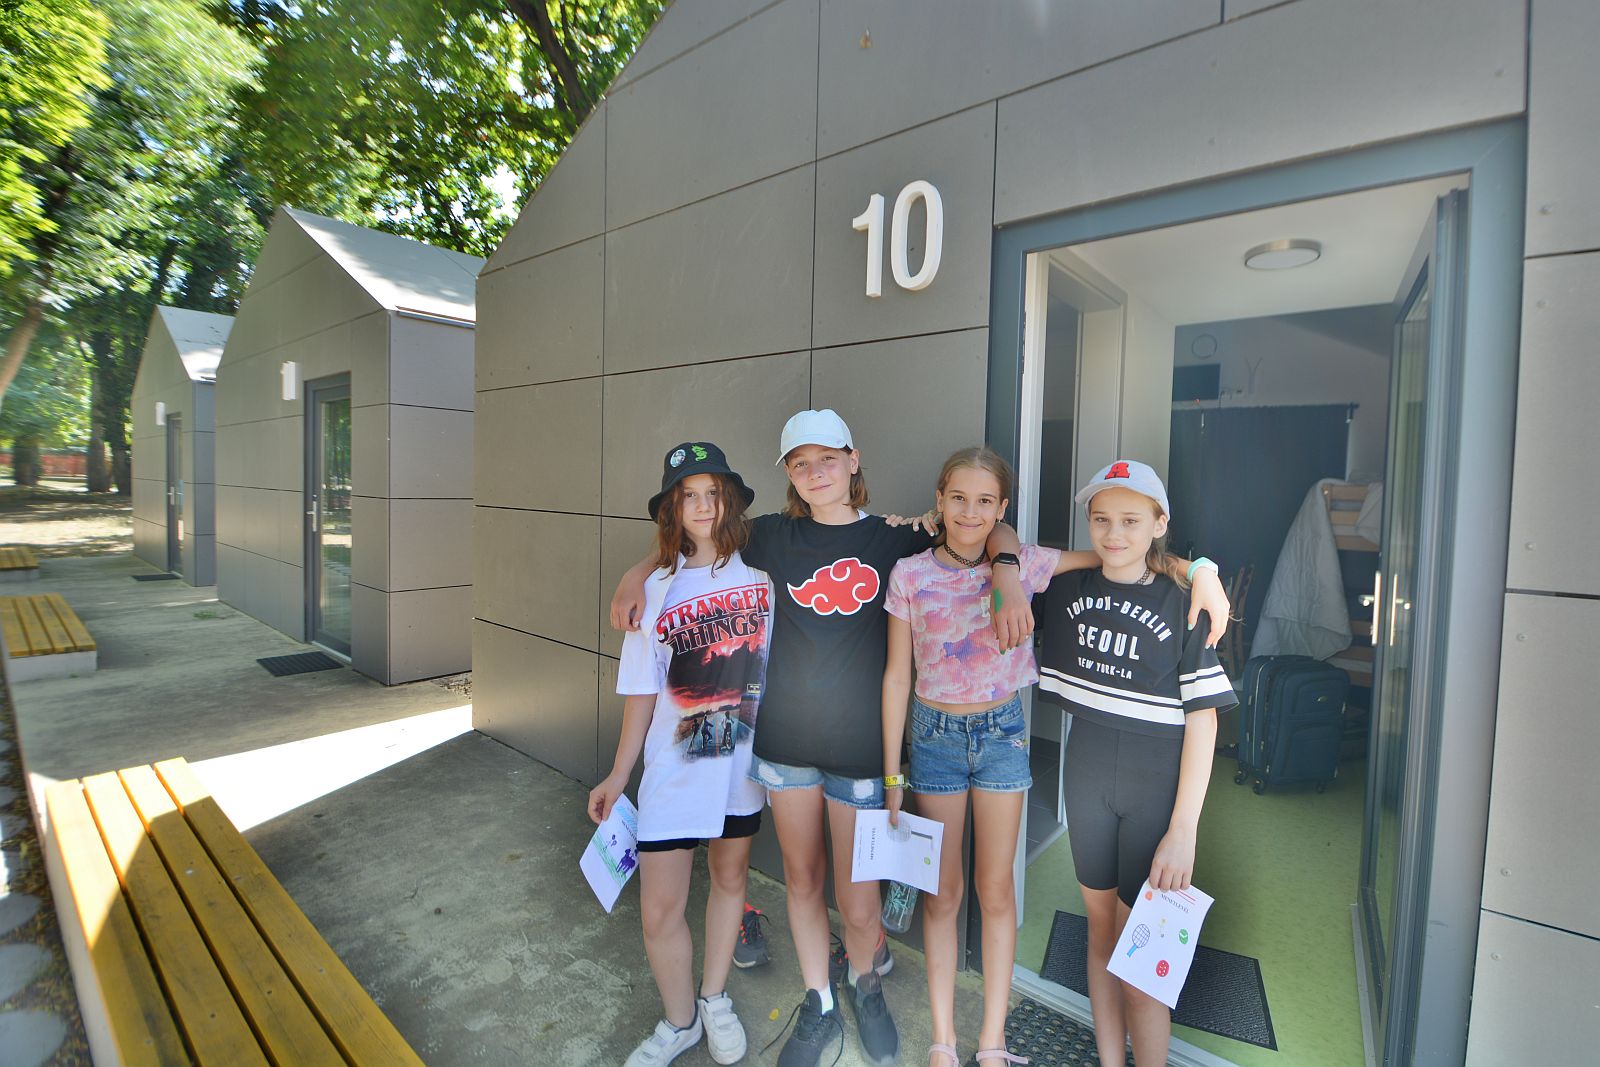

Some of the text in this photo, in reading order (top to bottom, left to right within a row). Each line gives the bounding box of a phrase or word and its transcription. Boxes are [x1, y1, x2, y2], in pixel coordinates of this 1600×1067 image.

[852, 180, 944, 297] 10
[656, 587, 769, 644] STRANGER
[672, 612, 759, 655] THINGS
[1077, 623, 1140, 661] SEOUL
